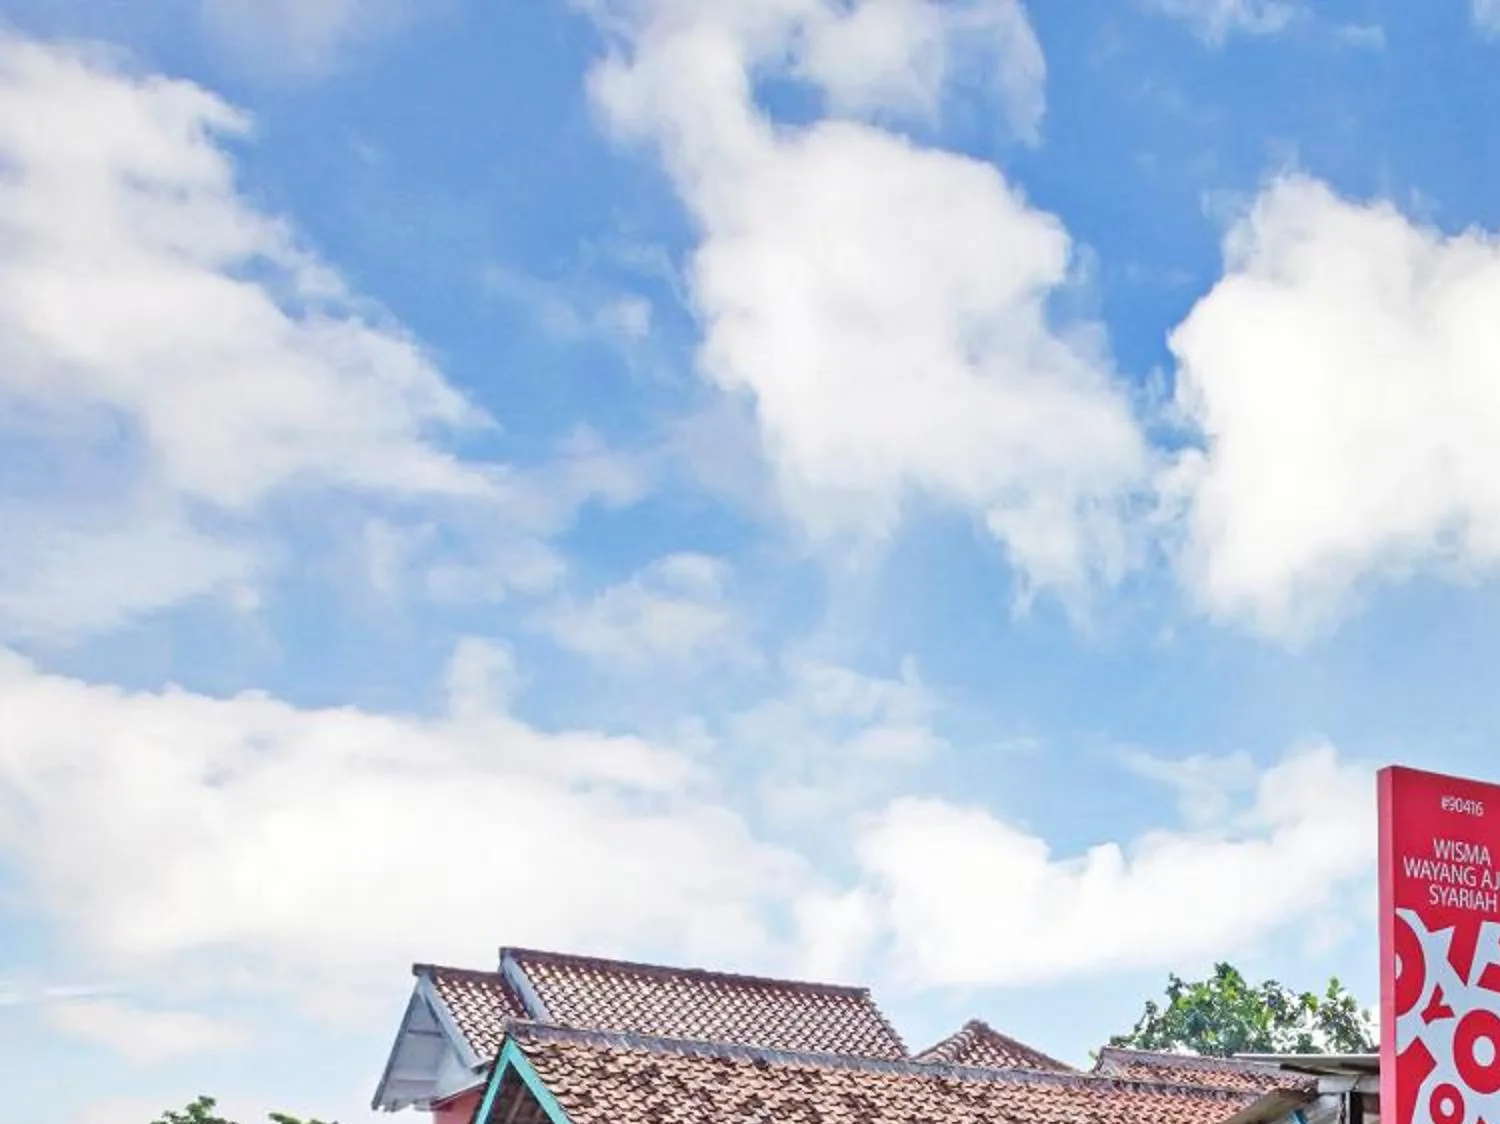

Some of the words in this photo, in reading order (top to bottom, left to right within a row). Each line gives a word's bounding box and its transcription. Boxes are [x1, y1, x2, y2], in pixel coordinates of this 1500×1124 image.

[1441, 796, 1484, 817] #90416
[1432, 838, 1492, 867] WISMA
[1403, 855, 1477, 887] WAYANG
[1429, 883, 1498, 913] SYARIAH
